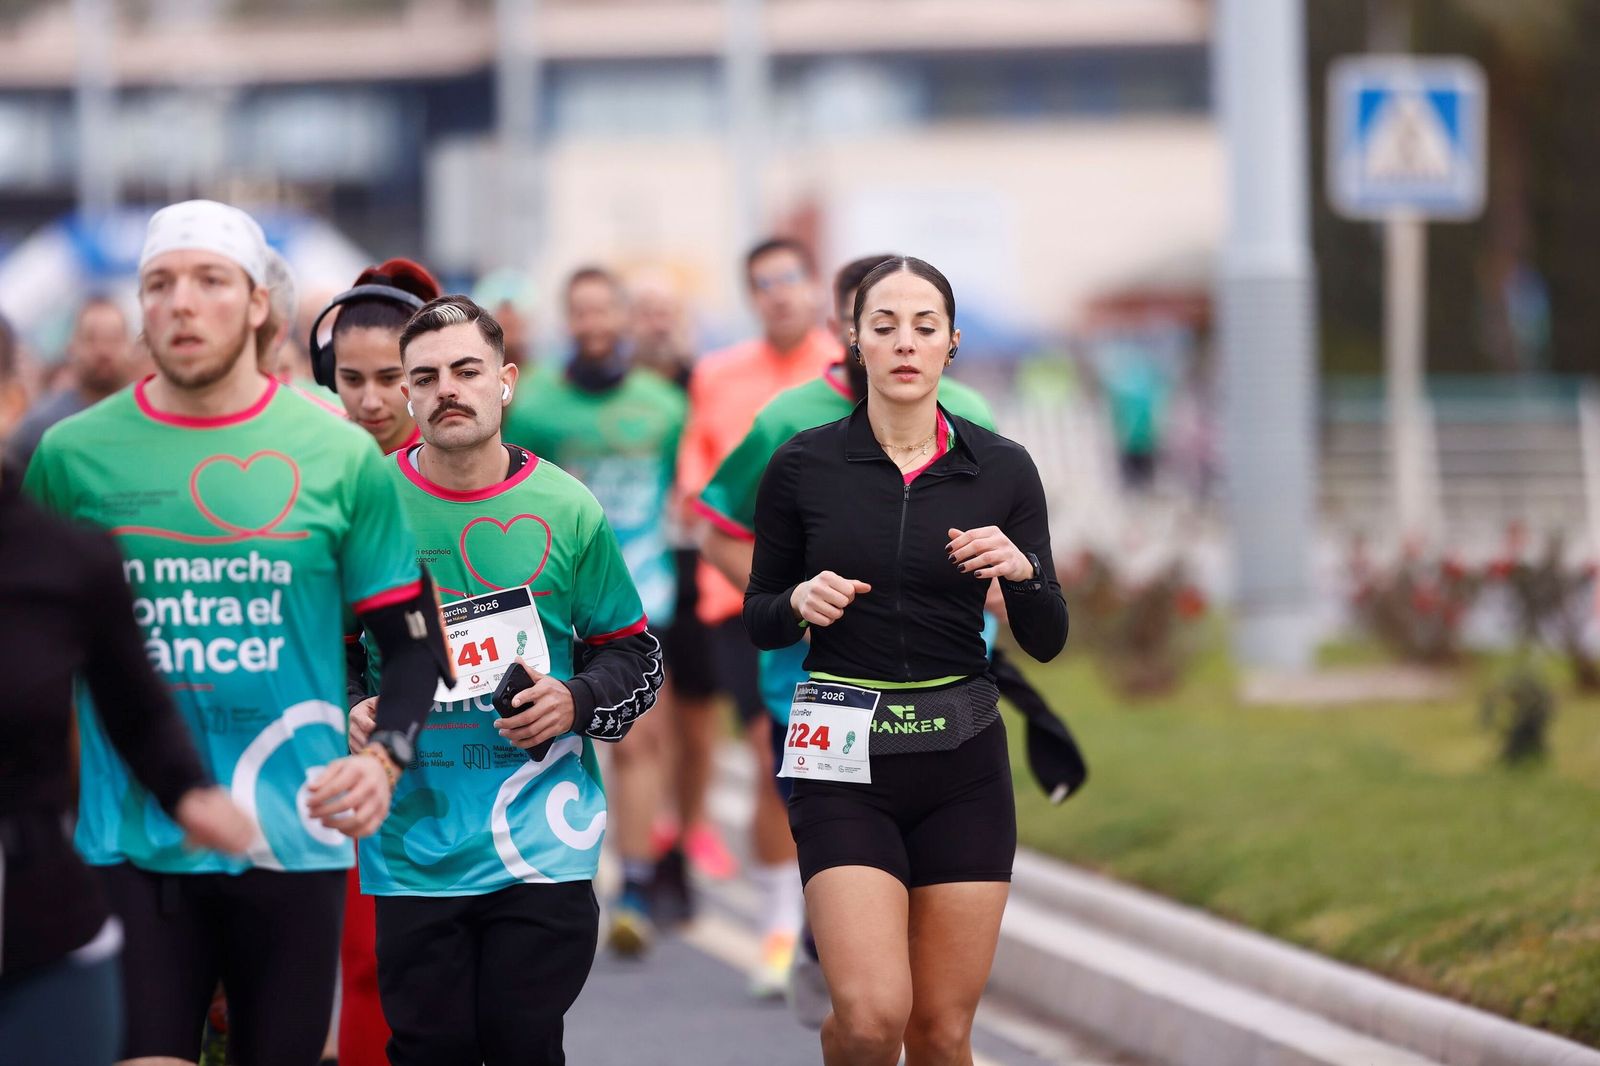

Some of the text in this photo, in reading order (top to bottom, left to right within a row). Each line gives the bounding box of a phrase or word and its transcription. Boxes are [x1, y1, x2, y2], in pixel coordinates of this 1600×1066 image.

[122, 550, 293, 585] n marcha
[132, 589, 283, 627] ontra el
[472, 599, 500, 615] 2026
[145, 626, 286, 674] áncer
[450, 636, 500, 667] 41
[821, 691, 846, 702] 2026
[787, 722, 831, 751] 224
[870, 717, 946, 734] HANKER
